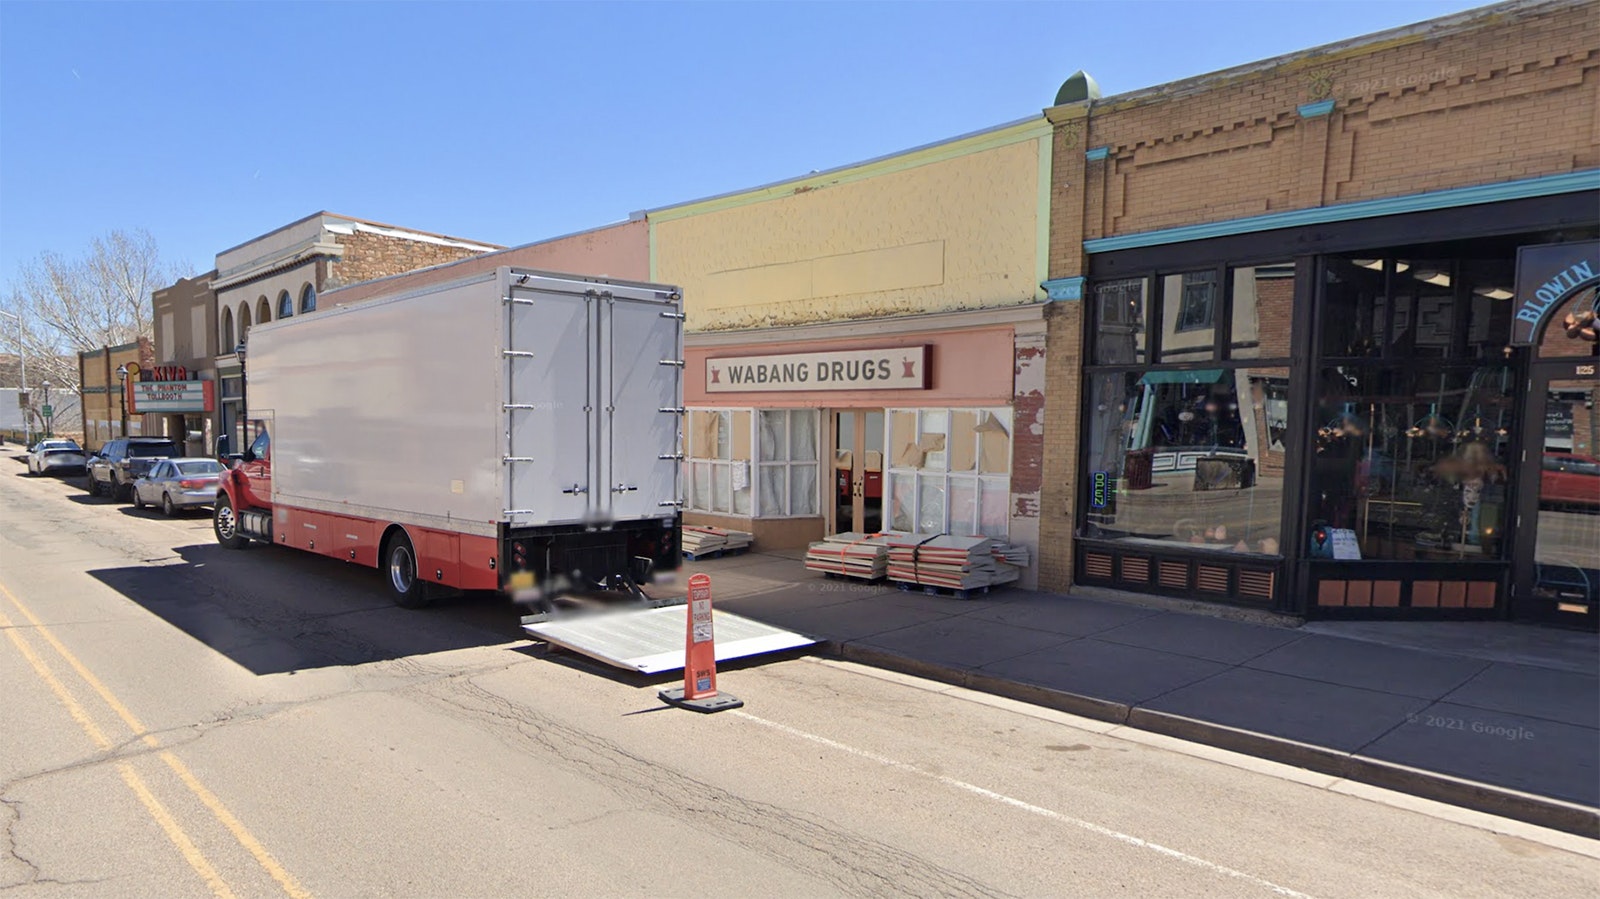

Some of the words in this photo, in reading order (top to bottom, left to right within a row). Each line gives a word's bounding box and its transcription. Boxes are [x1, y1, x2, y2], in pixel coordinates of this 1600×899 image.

[1516, 260, 1594, 323] BLOWIN
[153, 366, 187, 381] KIVA
[728, 363, 809, 384] WABANG
[817, 359, 891, 382] DRUGS
[1576, 365, 1595, 375] 125
[158, 384, 187, 392] PHANTOM
[1094, 473, 1105, 505] OPEN
